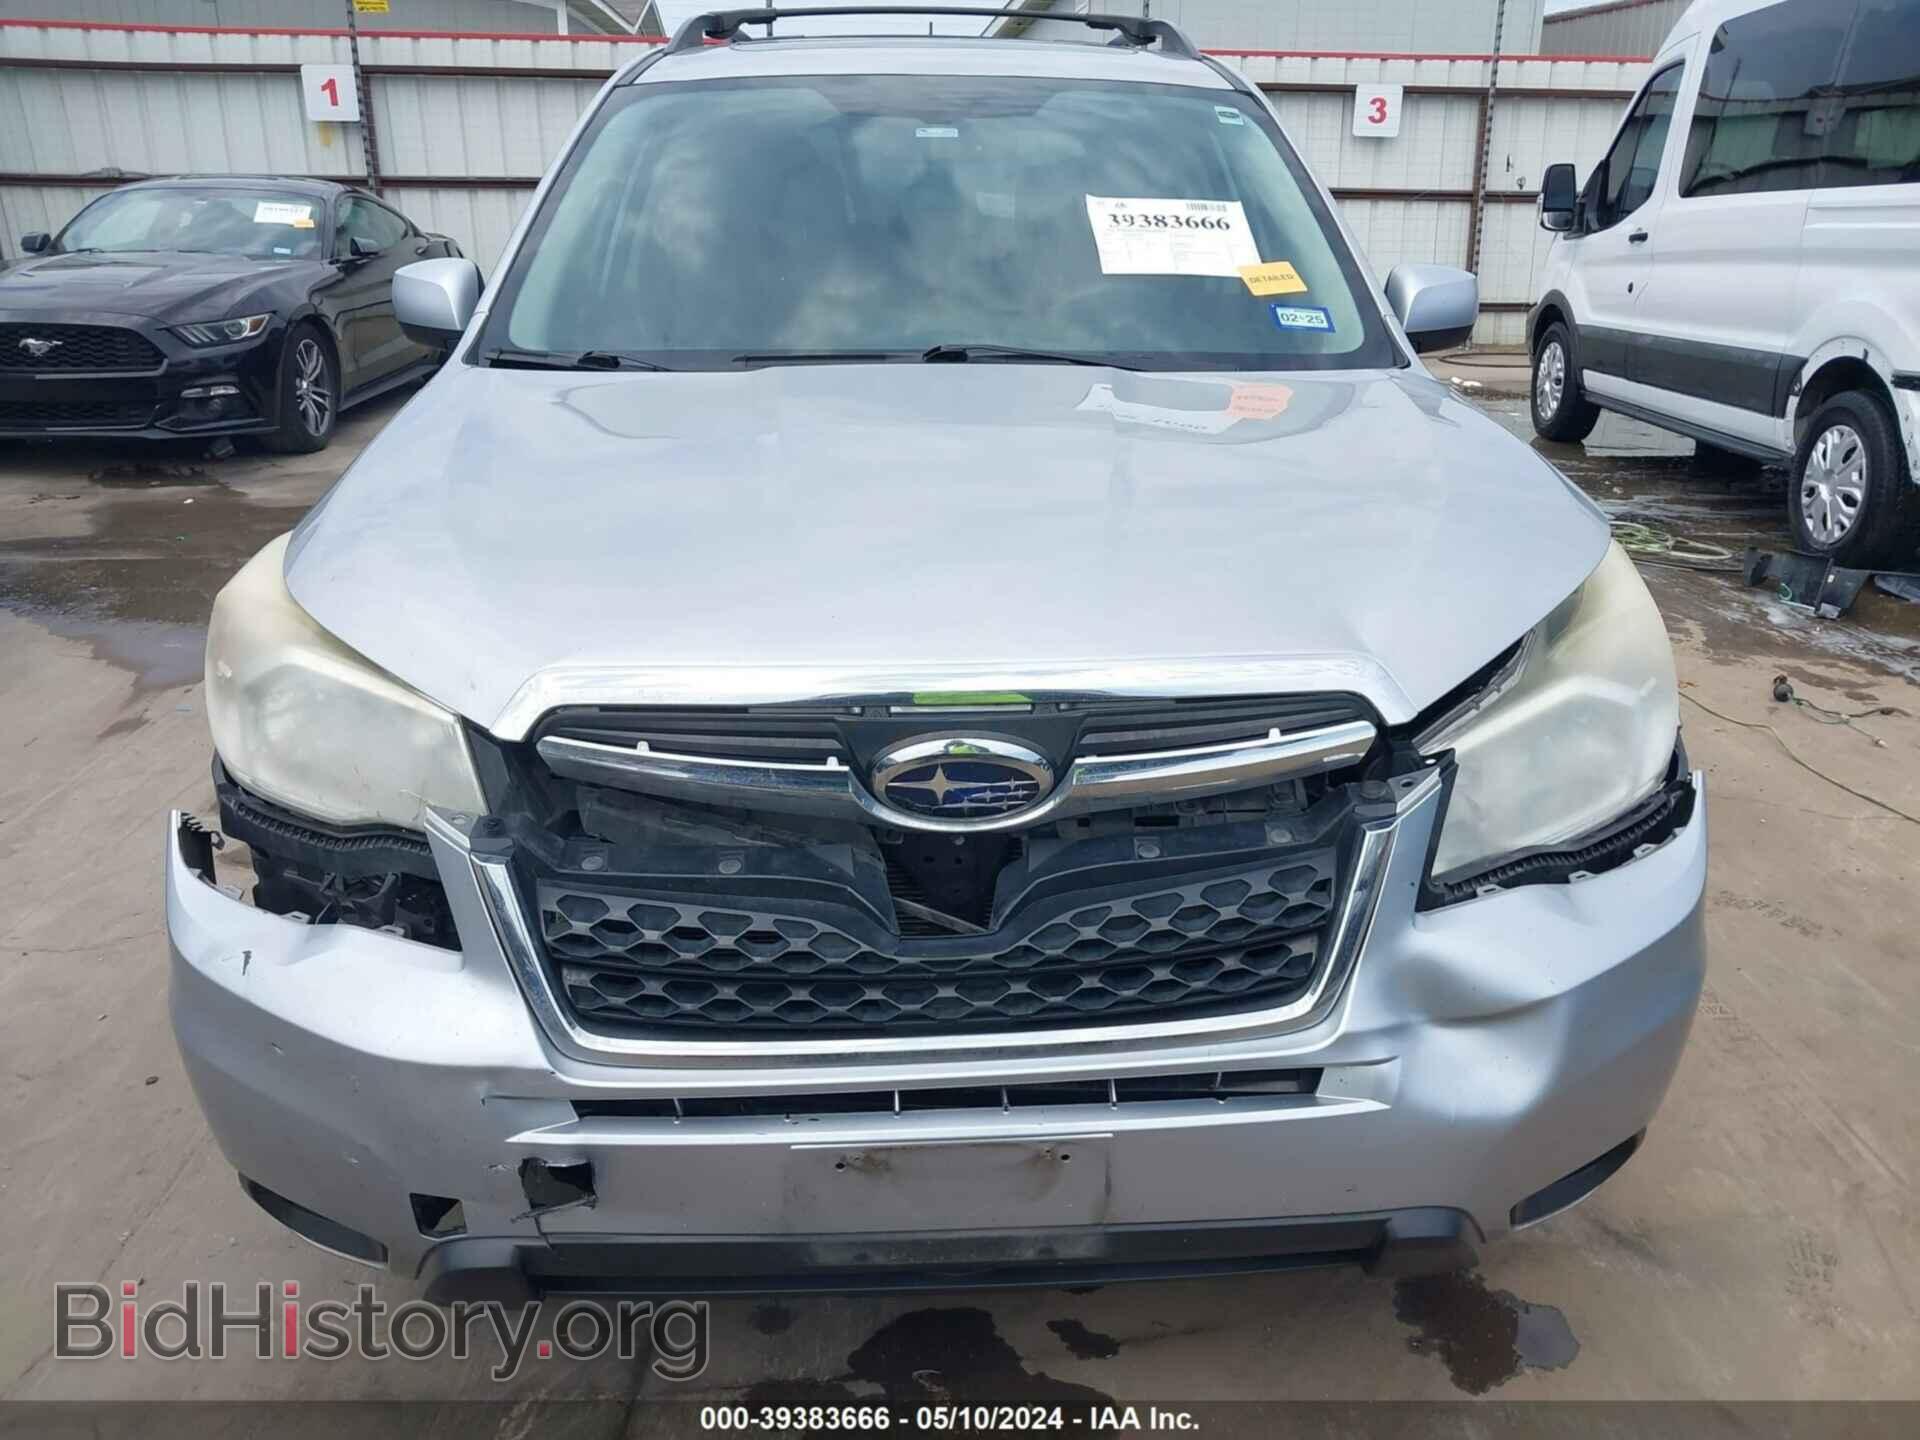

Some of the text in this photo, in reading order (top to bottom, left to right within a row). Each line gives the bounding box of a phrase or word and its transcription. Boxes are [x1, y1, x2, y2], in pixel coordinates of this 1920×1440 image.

[321, 78, 339, 107] 1
[1368, 96, 1388, 124] 3
[1108, 213, 1231, 231] 39383666
[1248, 273, 1296, 284] DETAILED
